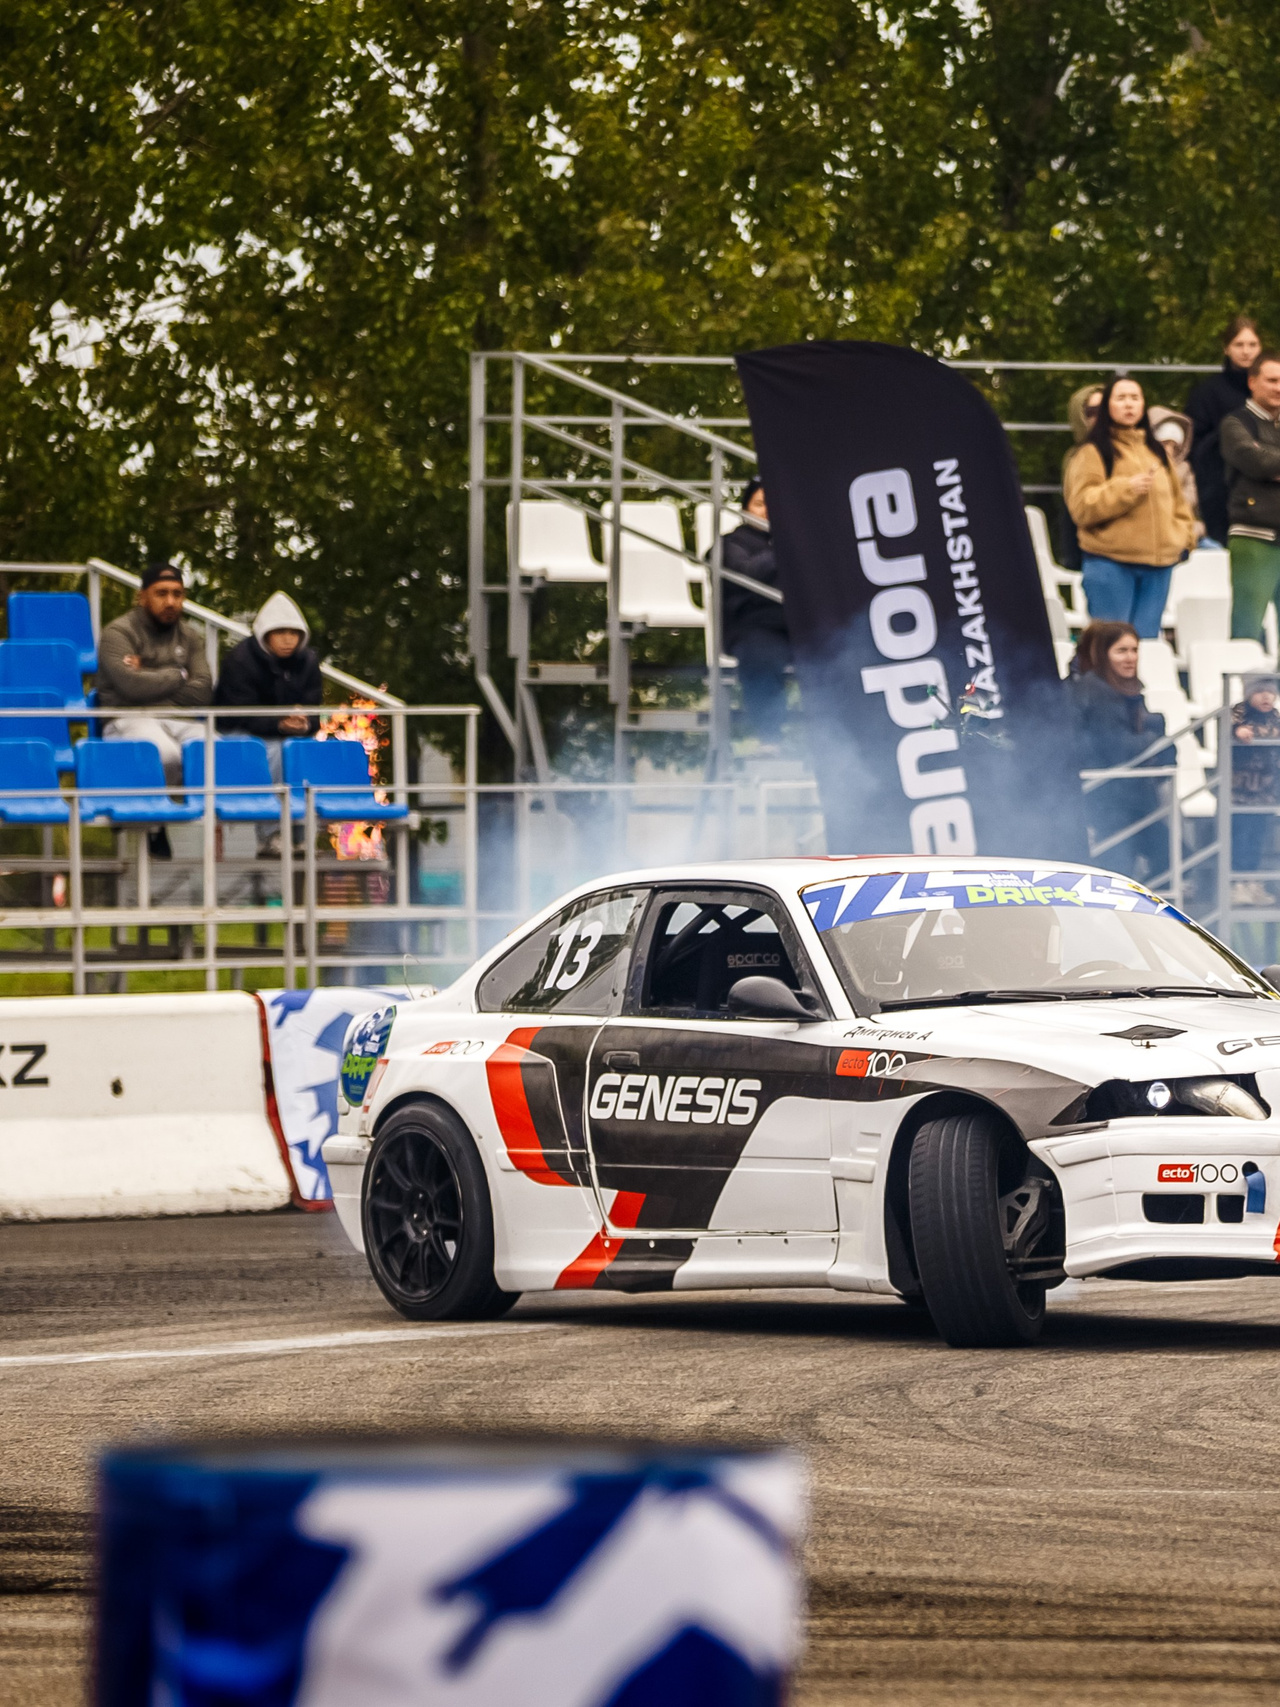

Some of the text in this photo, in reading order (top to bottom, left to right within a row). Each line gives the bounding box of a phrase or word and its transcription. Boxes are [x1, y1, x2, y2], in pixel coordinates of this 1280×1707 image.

[966, 886, 1084, 906] DRIFT
[544, 919, 604, 991] 13
[589, 1072, 762, 1125] GENESIS
